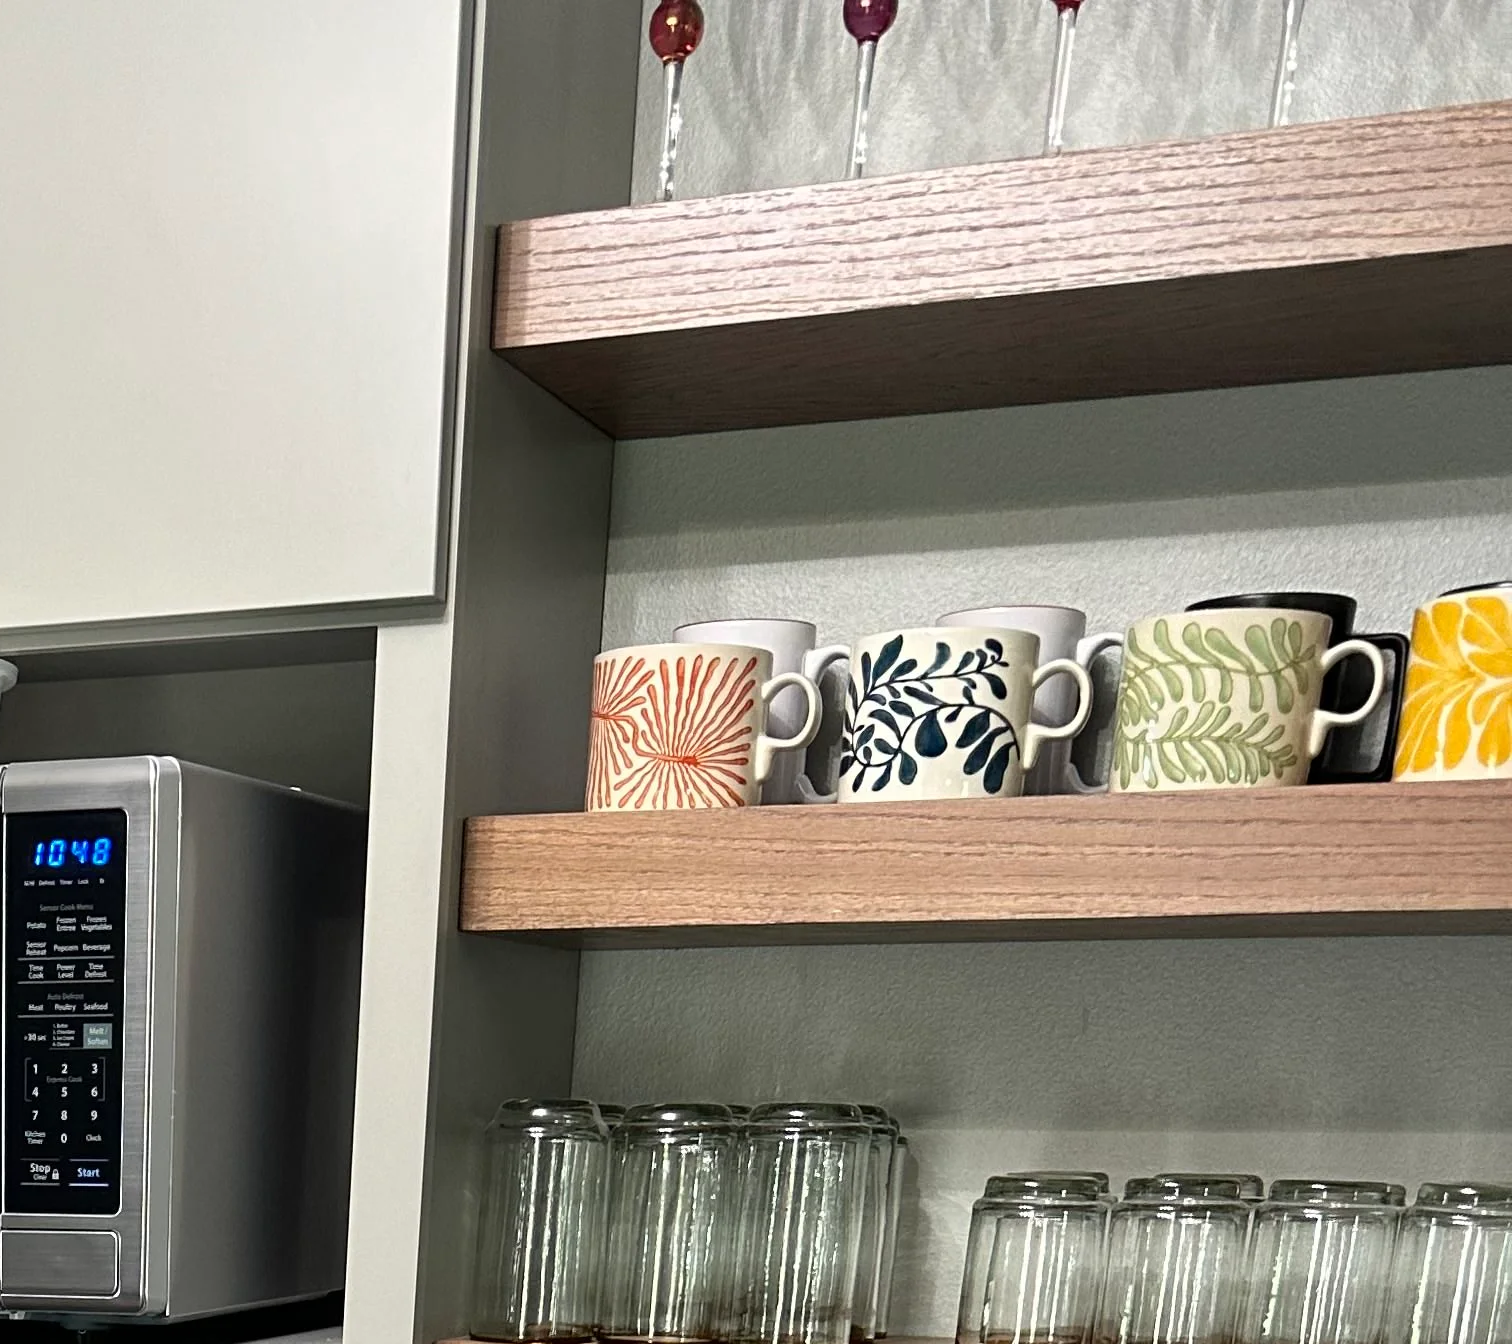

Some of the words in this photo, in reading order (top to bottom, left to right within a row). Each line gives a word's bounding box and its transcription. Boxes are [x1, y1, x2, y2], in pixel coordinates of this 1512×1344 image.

[81, 923, 112, 932] Vegetables
[54, 944, 78, 952] Popcorn
[83, 944, 110, 952] Beverage
[85, 970, 107, 978] Defrost
[55, 1004, 76, 1012] Poultry
[89, 1027, 104, 1035] Melt
[32, 1064, 38, 1075] 1
[61, 1064, 68, 1075] 2
[91, 1063, 99, 1075] 3
[31, 1087, 39, 1098] 4
[60, 1087, 68, 1098] 5
[90, 1087, 99, 1098] 6
[31, 1110, 39, 1121] 7
[60, 1110, 68, 1121] 8
[90, 1110, 98, 1121] 9
[60, 1133, 68, 1144] 0
[30, 1163, 50, 1174] Stop
[77, 1168, 99, 1177] Start
